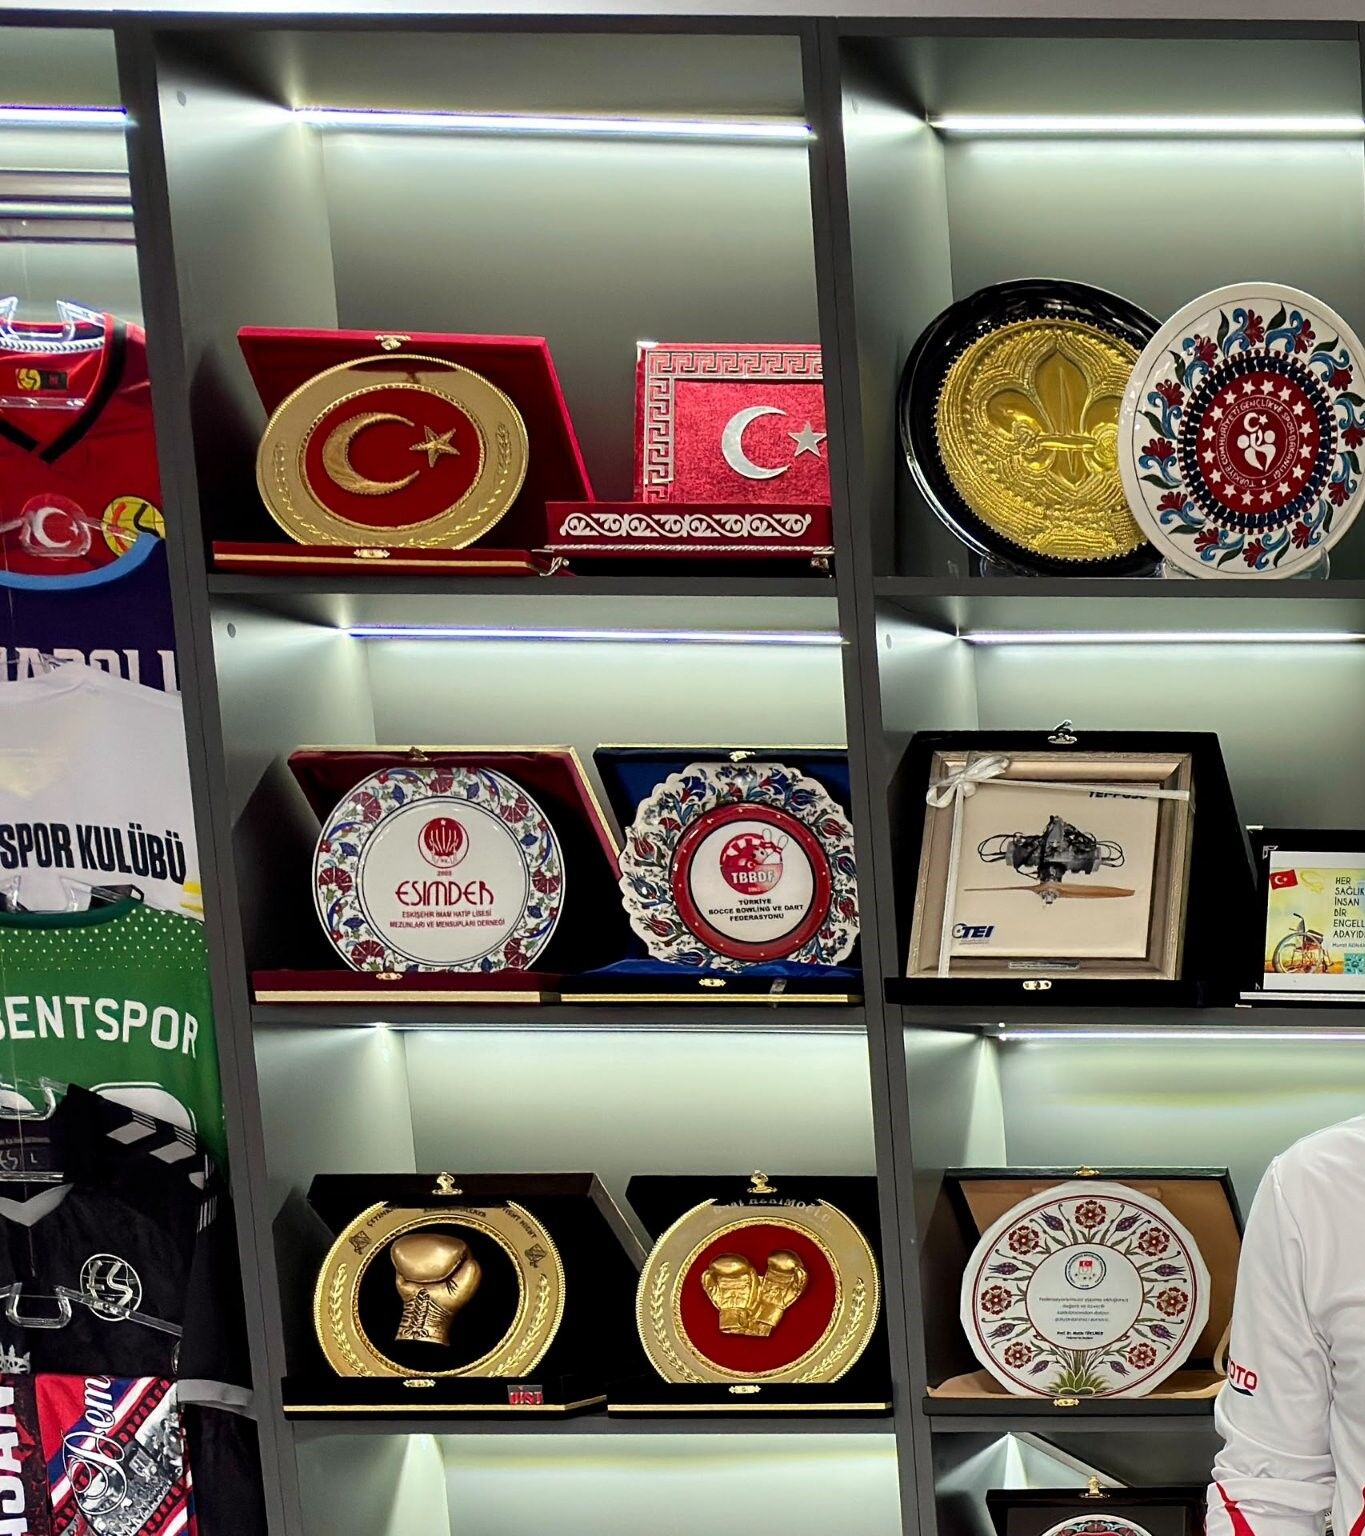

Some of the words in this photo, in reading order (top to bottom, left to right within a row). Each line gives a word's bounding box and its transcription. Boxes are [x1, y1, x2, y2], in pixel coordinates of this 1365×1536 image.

[0, 822, 75, 869] SPOR
[76, 822, 187, 886] KULÜBÜ
[1335, 876, 1351, 885] HER
[739, 898, 771, 906] TÜRKİYE
[1334, 896, 1360, 906] İNSAN
[1333, 907, 1347, 917] BİR
[729, 913, 785, 922] FEDERASYONU
[0, 996, 199, 1058] ENTSPOR
